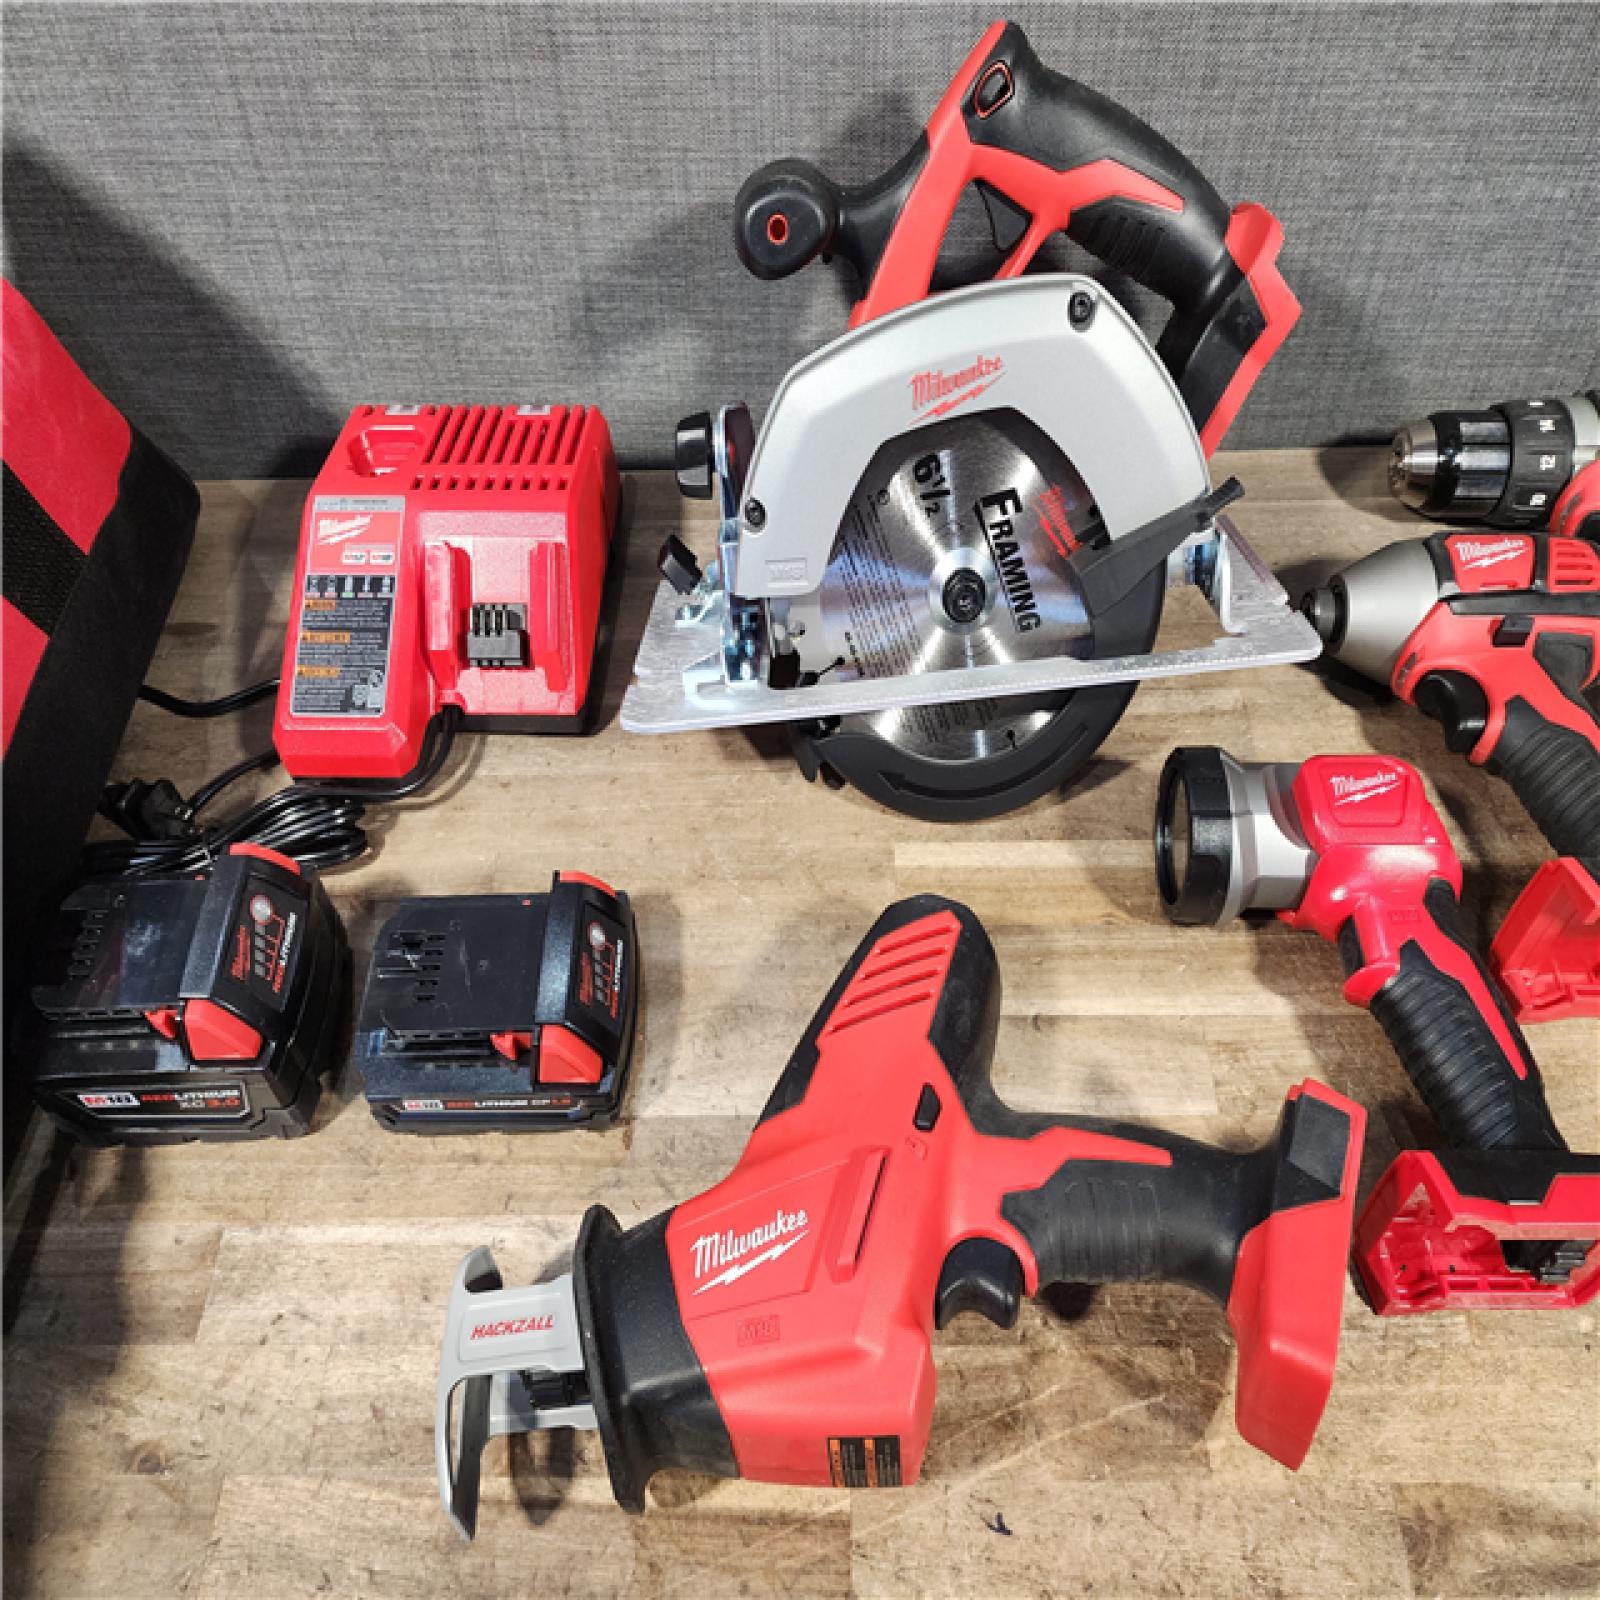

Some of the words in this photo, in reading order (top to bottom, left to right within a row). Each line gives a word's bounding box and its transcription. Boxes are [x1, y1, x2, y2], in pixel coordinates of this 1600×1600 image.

[972, 487, 1041, 633] FRAMING
[690, 1209, 809, 1279] Milwaukee
[470, 1314, 555, 1341] HACKZALL
